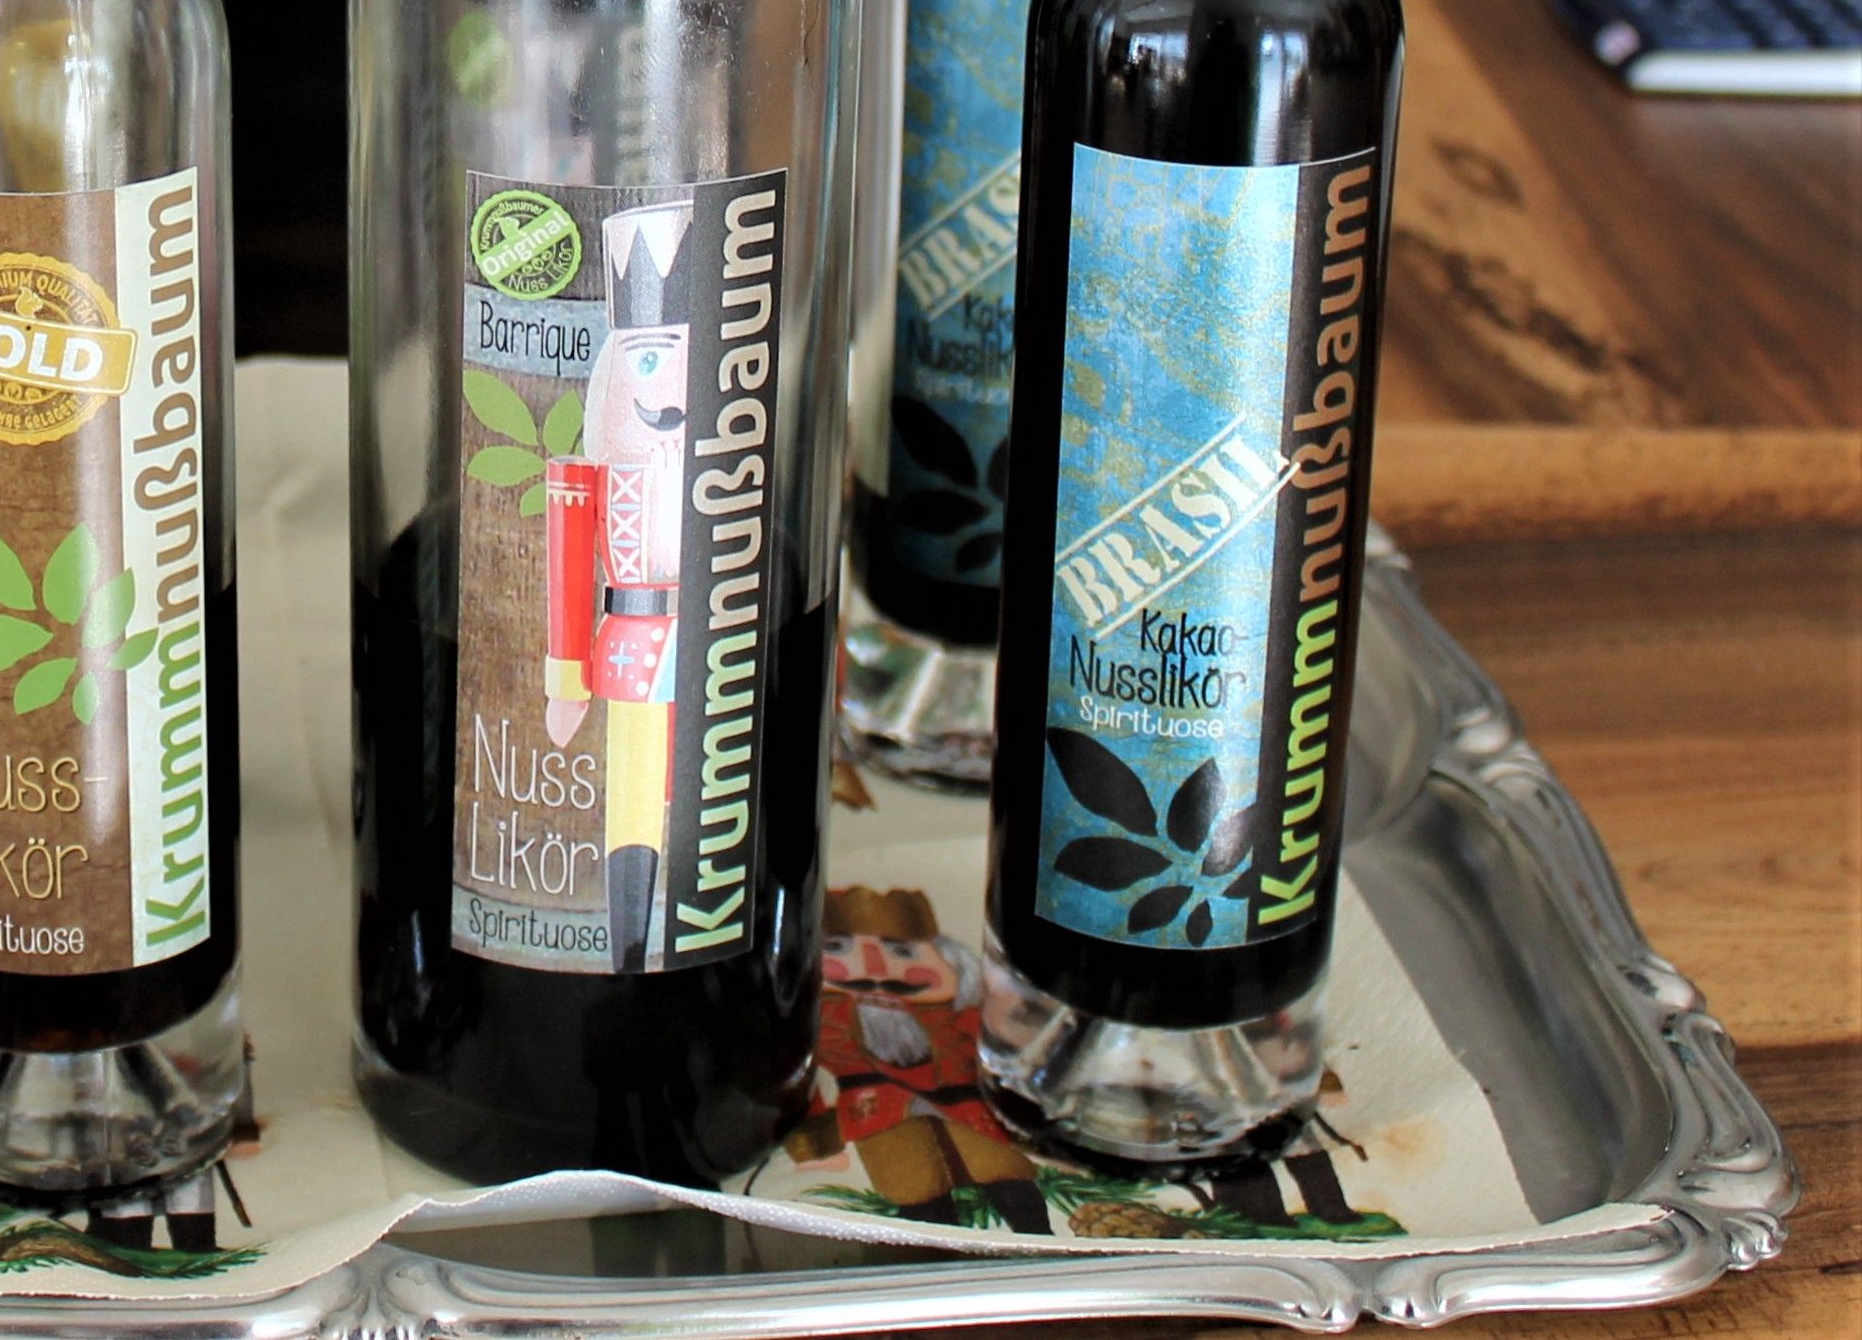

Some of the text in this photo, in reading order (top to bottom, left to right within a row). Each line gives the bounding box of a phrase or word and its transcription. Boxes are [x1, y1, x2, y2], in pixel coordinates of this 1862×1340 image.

[482, 211, 569, 276] Original
[480, 300, 591, 377] Barrique
[134, 185, 206, 947] Krummnußbaum
[675, 189, 776, 953] Krummnußbaum
[1056, 434, 1290, 628] BRASIL
[1258, 164, 1371, 926] Krummnußbaum
[1069, 633, 1246, 709] Nusslikör
[1080, 696, 1224, 739] Spirituose
[473, 713, 597, 810] Nuss
[470, 802, 600, 896] Likör
[469, 897, 608, 952] Spirituose
